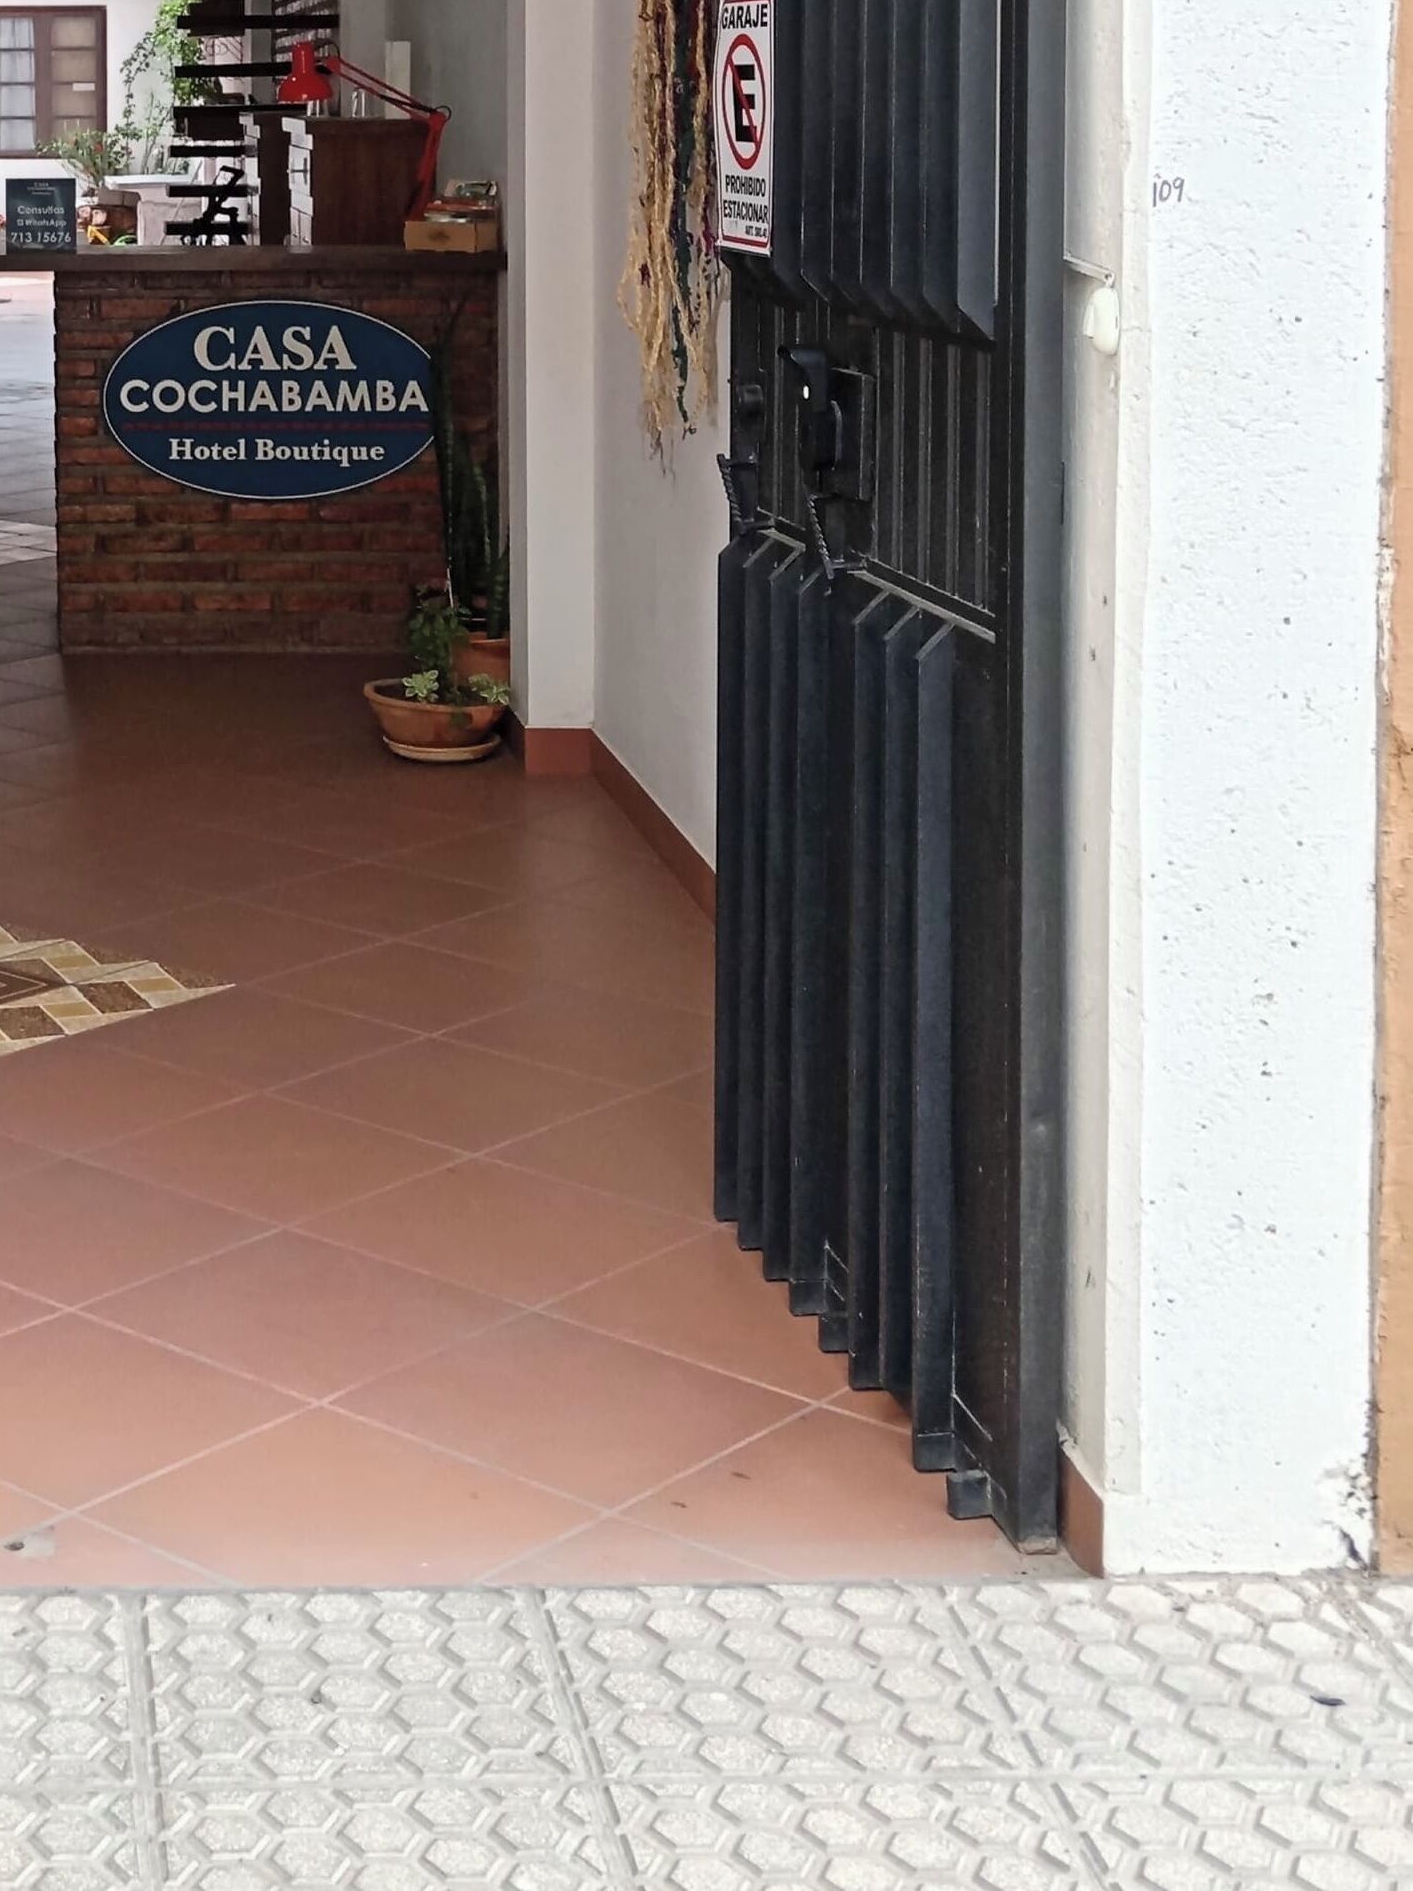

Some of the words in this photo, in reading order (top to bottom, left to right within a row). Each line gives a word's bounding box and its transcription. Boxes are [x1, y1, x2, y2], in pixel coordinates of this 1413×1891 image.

[721, 3, 768, 30] GARAJE
[732, 64, 757, 142] E
[725, 174, 766, 197] PROHIBIDO
[17, 205, 65, 215] Consultas
[25, 219, 67, 227] WhatsApp
[723, 199, 769, 224] ESTACIONAR
[11, 232, 33, 243] 713
[37, 232, 71, 243] 15676
[193, 325, 357, 372] CASA
[119, 379, 430, 413] COCHABAMBA
[169, 438, 248, 461] Hotel
[255, 438, 385, 467] Boutique
